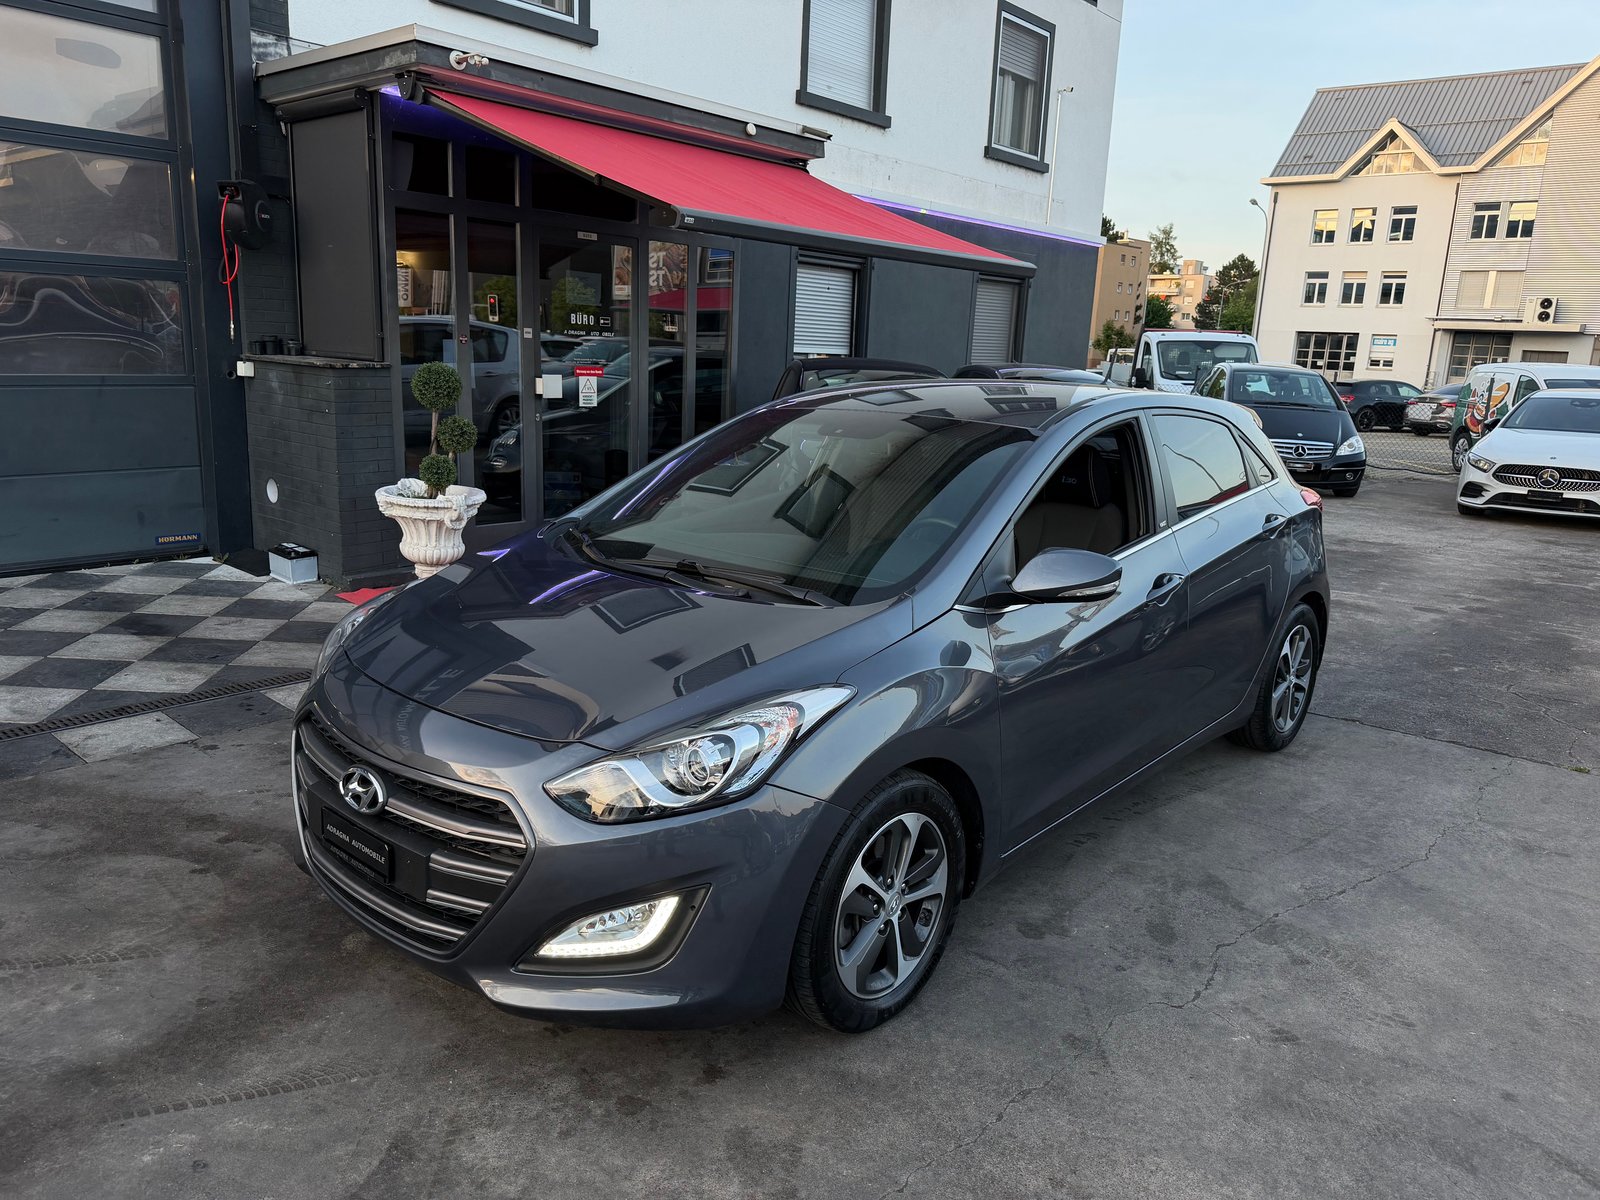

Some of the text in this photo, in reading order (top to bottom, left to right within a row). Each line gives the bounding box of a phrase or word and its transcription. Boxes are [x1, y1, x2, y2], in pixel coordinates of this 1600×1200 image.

[570, 312, 595, 326] BÜRO
[326, 823, 350, 843] ADRAGNA
[351, 839, 386, 864] AUTOMOBILE
